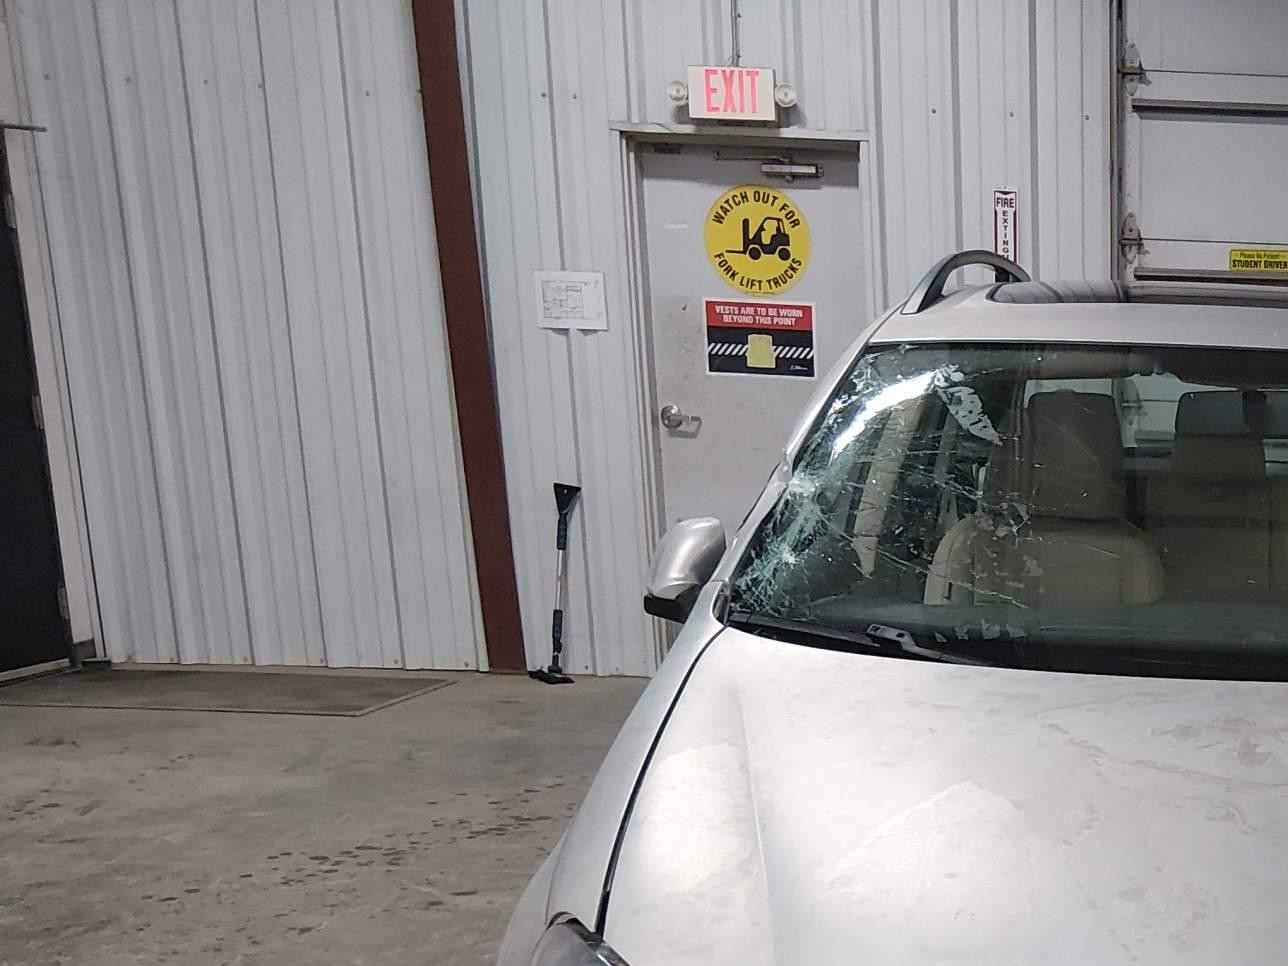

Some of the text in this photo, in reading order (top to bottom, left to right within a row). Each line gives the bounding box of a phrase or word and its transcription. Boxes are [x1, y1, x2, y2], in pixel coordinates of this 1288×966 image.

[704, 69, 759, 113] EXIT
[712, 190, 801, 229] WATCH OUT FOR
[996, 197, 1015, 209] FIRE
[1232, 259, 1288, 270] STUDENT DRIVER
[714, 252, 802, 291] FORK LIFT TRUCKS
[715, 305, 803, 318] VESTS ARE TO BE WORN
[723, 315, 797, 326] BEYOND THIS POINT
